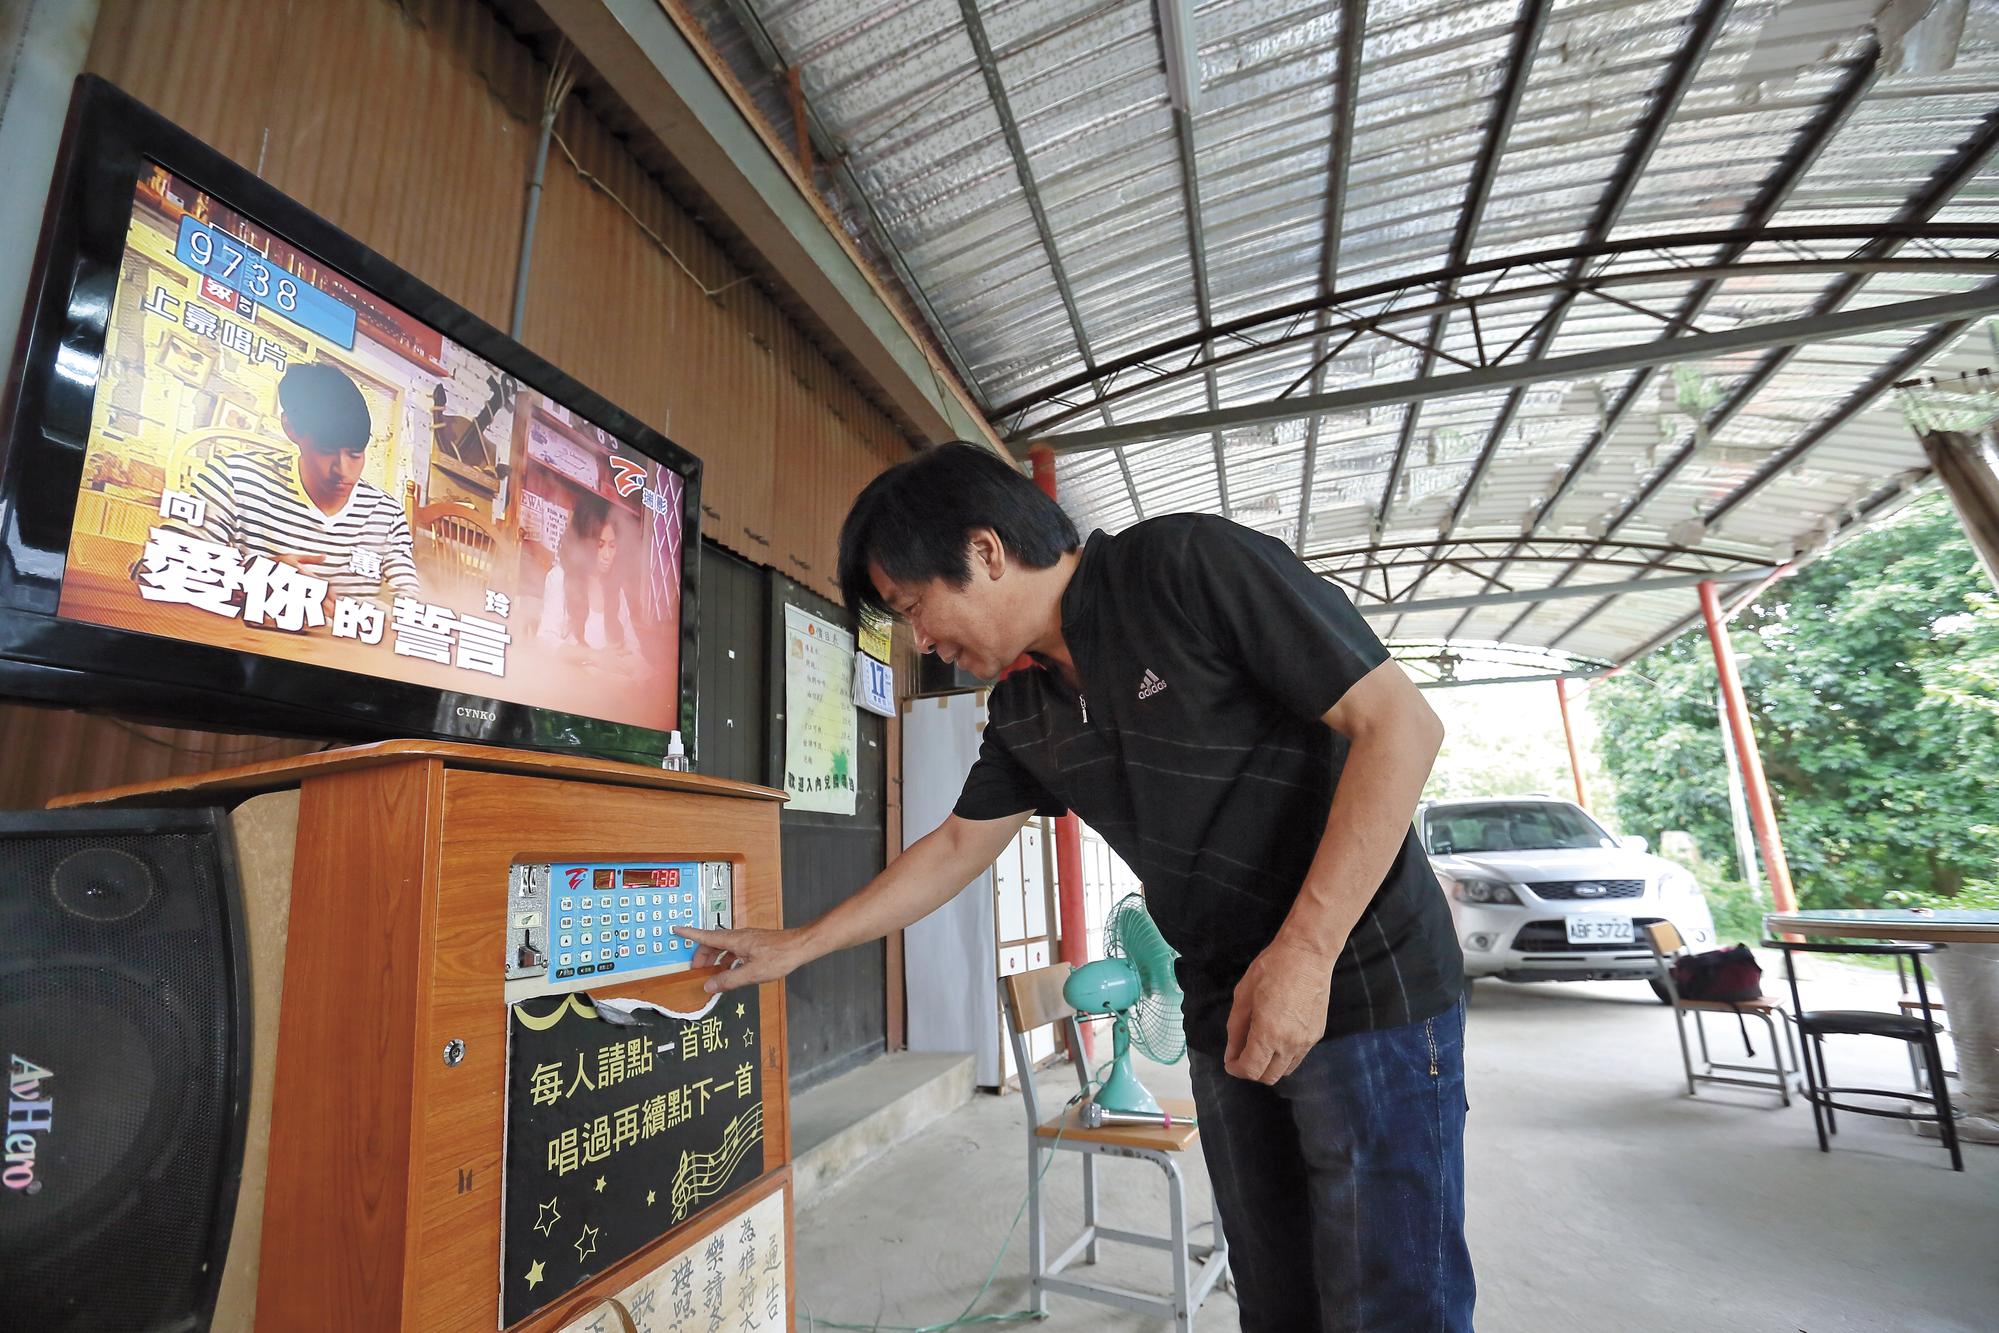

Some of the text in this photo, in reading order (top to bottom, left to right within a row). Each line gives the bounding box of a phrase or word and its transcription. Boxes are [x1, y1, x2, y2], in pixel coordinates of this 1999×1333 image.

[189, 230, 297, 312] 9738
[144, 286, 287, 372] 上豪唱片
[159, 489, 206, 527] 向
[485, 589, 511, 618] 玲
[138, 527, 512, 677] 愛你的誓言
[456, 707, 496, 722] CYNKO
[870, 661, 886, 699] 17
[1138, 679, 1167, 700] adidas
[2, 1053, 54, 1190] AvHero
[547, 1062, 753, 1177] 唱過再續點下一首
[763, 1233, 781, 1320] 通告
